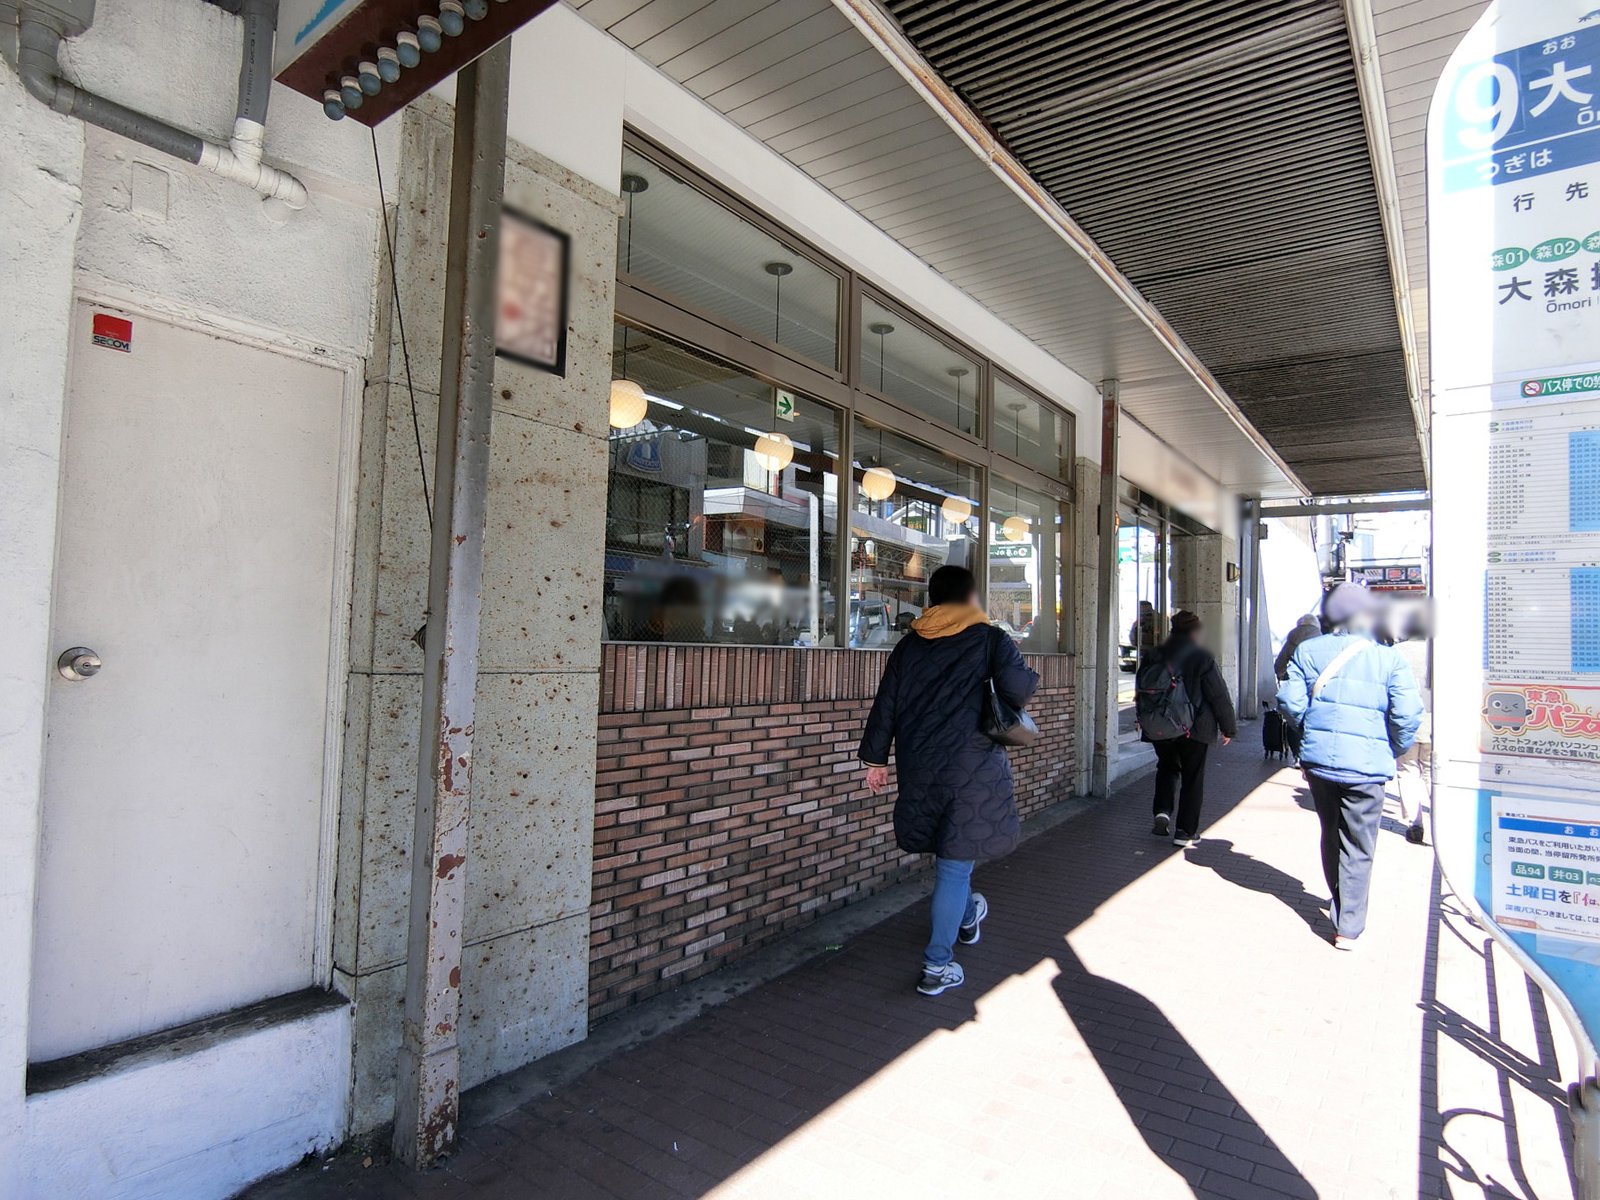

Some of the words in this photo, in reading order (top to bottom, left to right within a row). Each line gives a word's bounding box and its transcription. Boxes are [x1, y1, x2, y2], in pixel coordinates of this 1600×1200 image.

[1542, 35, 1576, 56] おお
[1528, 60, 1594, 118] 大
[1455, 62, 1520, 150] 9
[1476, 148, 1554, 182] つぎは
[1535, 240, 1577, 261] 森02
[1545, 296, 1592, 314] Ōmori
[93, 335, 130, 350] SECOM
[1526, 690, 1561, 704] 東急
[1515, 865, 1542, 876] 品94
[1553, 869, 1580, 881] 井03
